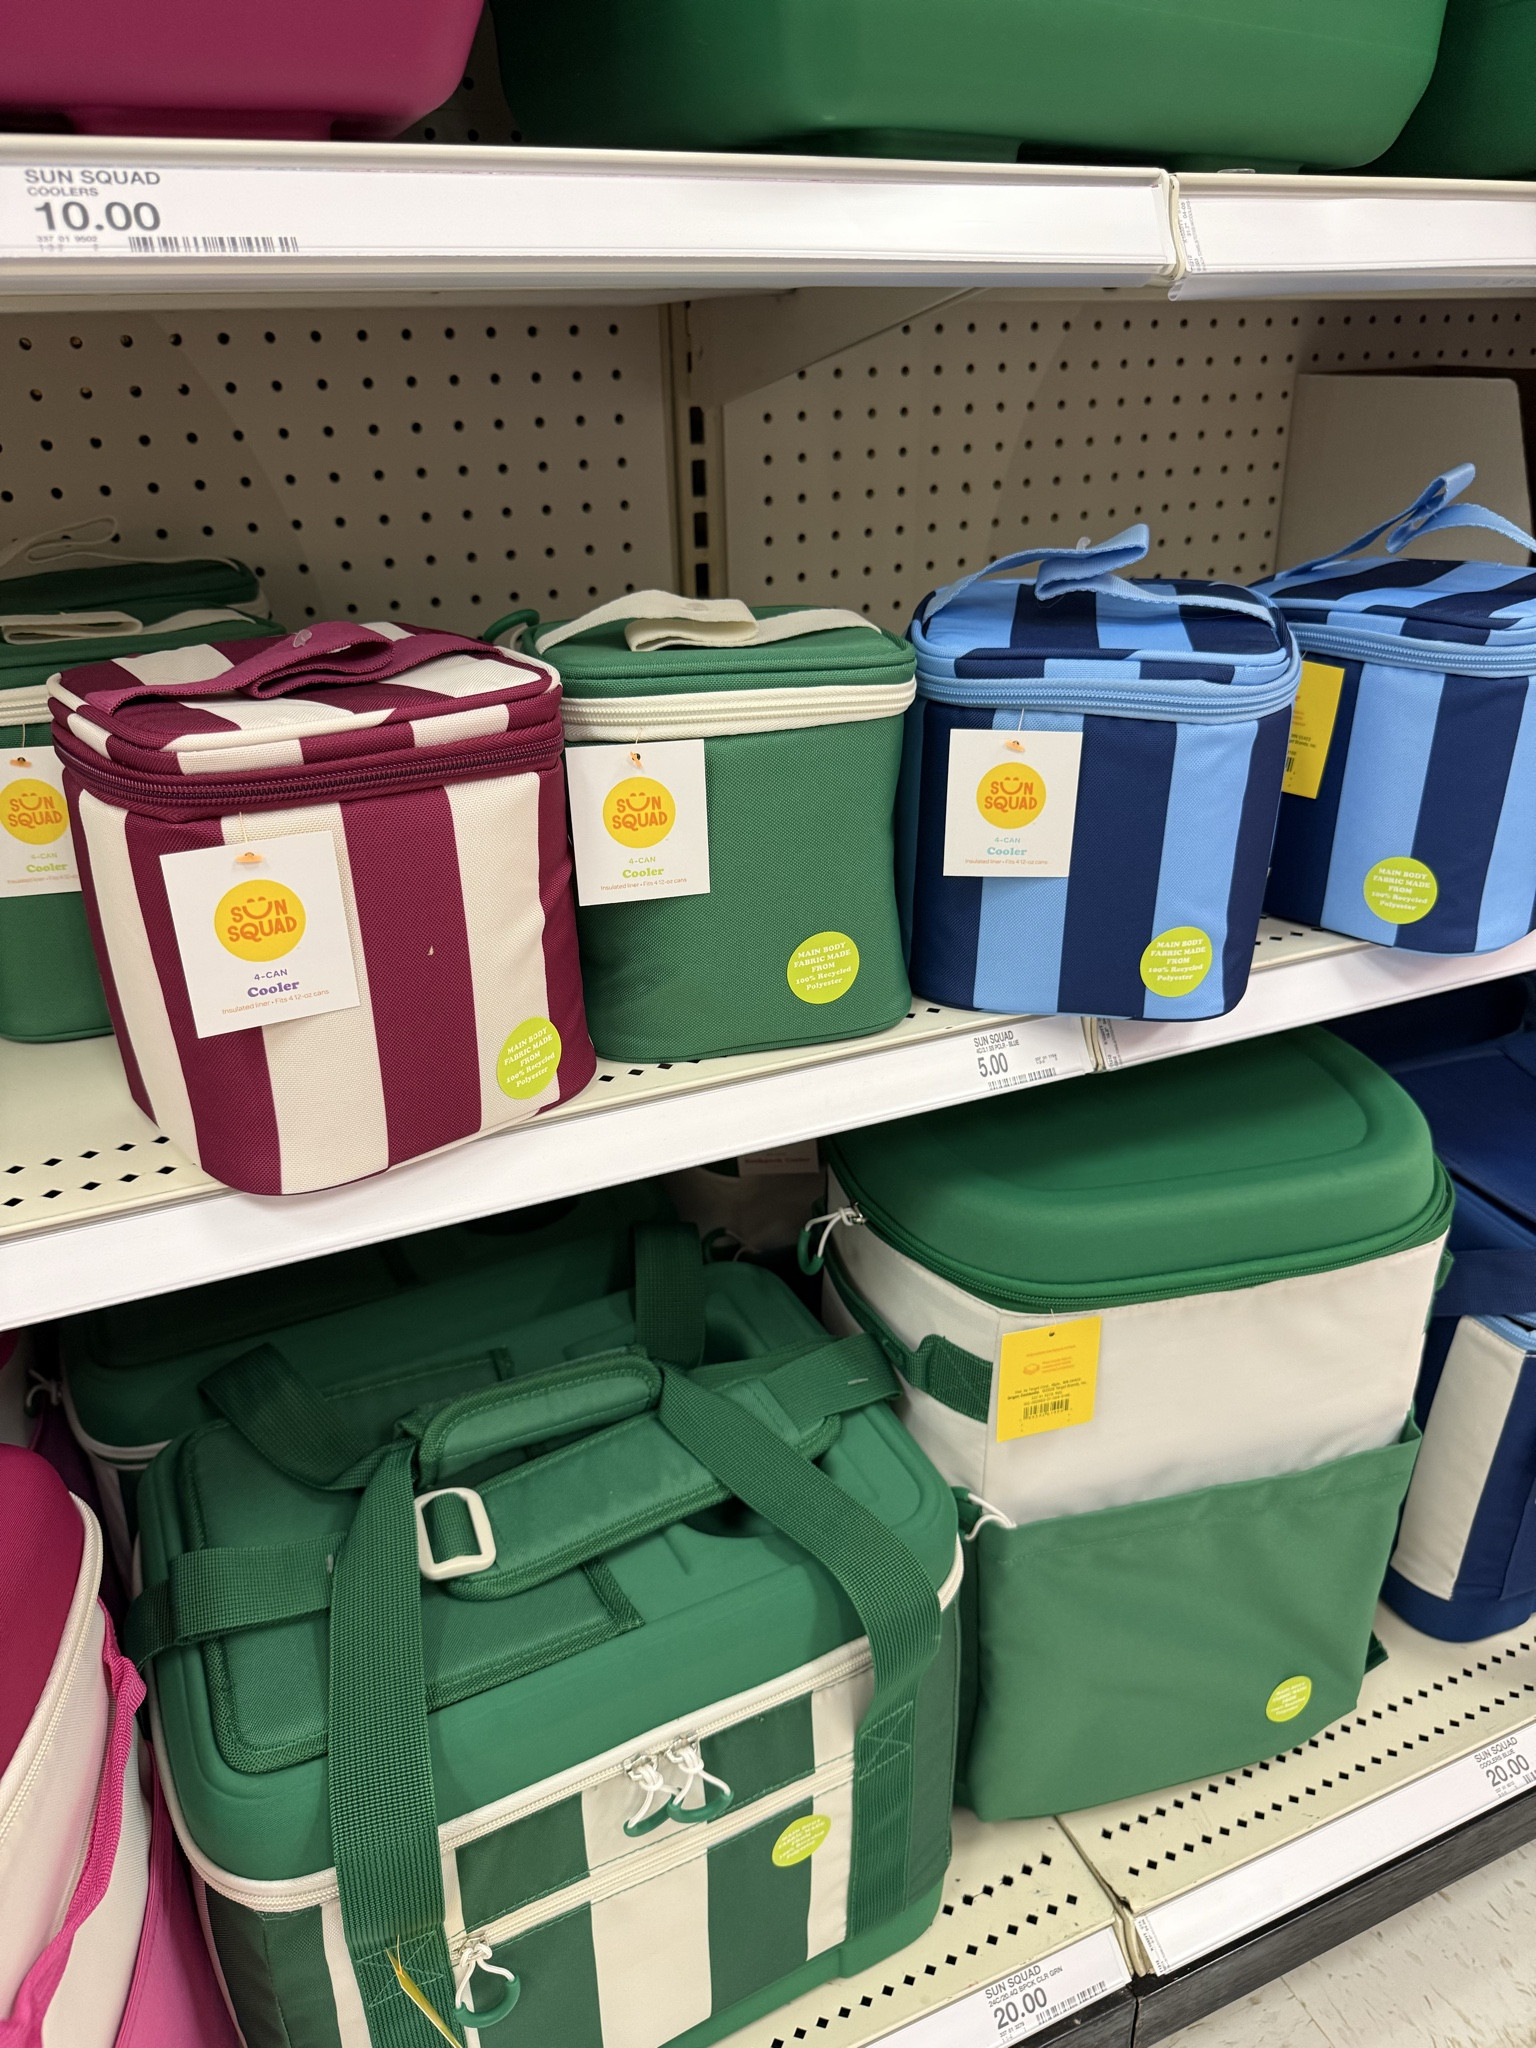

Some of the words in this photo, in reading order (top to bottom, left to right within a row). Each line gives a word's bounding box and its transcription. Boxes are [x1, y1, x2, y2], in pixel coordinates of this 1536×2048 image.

[24, 169, 73, 184] SUN
[80, 170, 161, 185] SQUAD
[27, 187, 99, 197] COOLERS
[34, 201, 161, 231] 10.00
[990, 780, 1034, 795] SUN
[10, 796, 55, 812] SUN
[616, 795, 662, 813] SUN
[984, 796, 1037, 813] SQUAD
[8, 811, 63, 829] SQUAD
[612, 812, 667, 831] SQUAD
[987, 847, 1027, 856] Cooler
[26, 863, 68, 872] Cooler
[622, 868, 664, 878] Cooler
[601, 883, 626, 891] Insulated
[231, 898, 288, 923] SUN
[227, 916, 297, 942] SQUAD
[798, 948, 821, 958] MAIN
[823, 942, 846, 953] BODY
[1182, 939, 1203, 947] BODY
[1184, 947, 1206, 955] MADE
[794, 956, 825, 968] FABRIC
[827, 949, 851, 960] MADE
[811, 962, 835, 973] FROM
[254, 969, 288, 981] 4-CAN
[796, 976, 815, 984] 100%
[818, 966, 852, 979] Recycled
[247, 981, 300, 997] Cooler
[806, 978, 842, 991] Polyester
[222, 1002, 254, 1015] Insulated
[255, 1000, 270, 1009] liner
[294, 993, 312, 1001] 12-oz
[508, 1039, 527, 1055] MAIN
[529, 1027, 548, 1043] BODY
[974, 1036, 989, 1047] SUN
[989, 1031, 1014, 1044] SQUAD
[1008, 1039, 1020, 1047] BLUE
[504, 1047, 531, 1066] FABRIC
[533, 1034, 553, 1050] MADE
[520, 1051, 540, 1066] FROM
[507, 1070, 525, 1083] 100%
[526, 1052, 555, 1073] Recycled
[977, 1052, 1008, 1077] 5.00
[516, 1067, 548, 1088] Polyester
[1474, 1749, 1492, 1763] SUN
[1491, 1736, 1518, 1754] SQUAD
[1480, 1754, 1503, 1769] COOLERS
[1502, 1748, 1516, 1759] BLUE
[1486, 1754, 1530, 1787] 20.00
[985, 1982, 1006, 1999] SUN
[1007, 1965, 1041, 1988] SQUAD
[1019, 1979, 1036, 1992] BPCK
[1036, 1973, 1049, 1983] CLR
[1049, 1965, 1063, 1977] GRN
[993, 1987, 1047, 2030] 20.00
